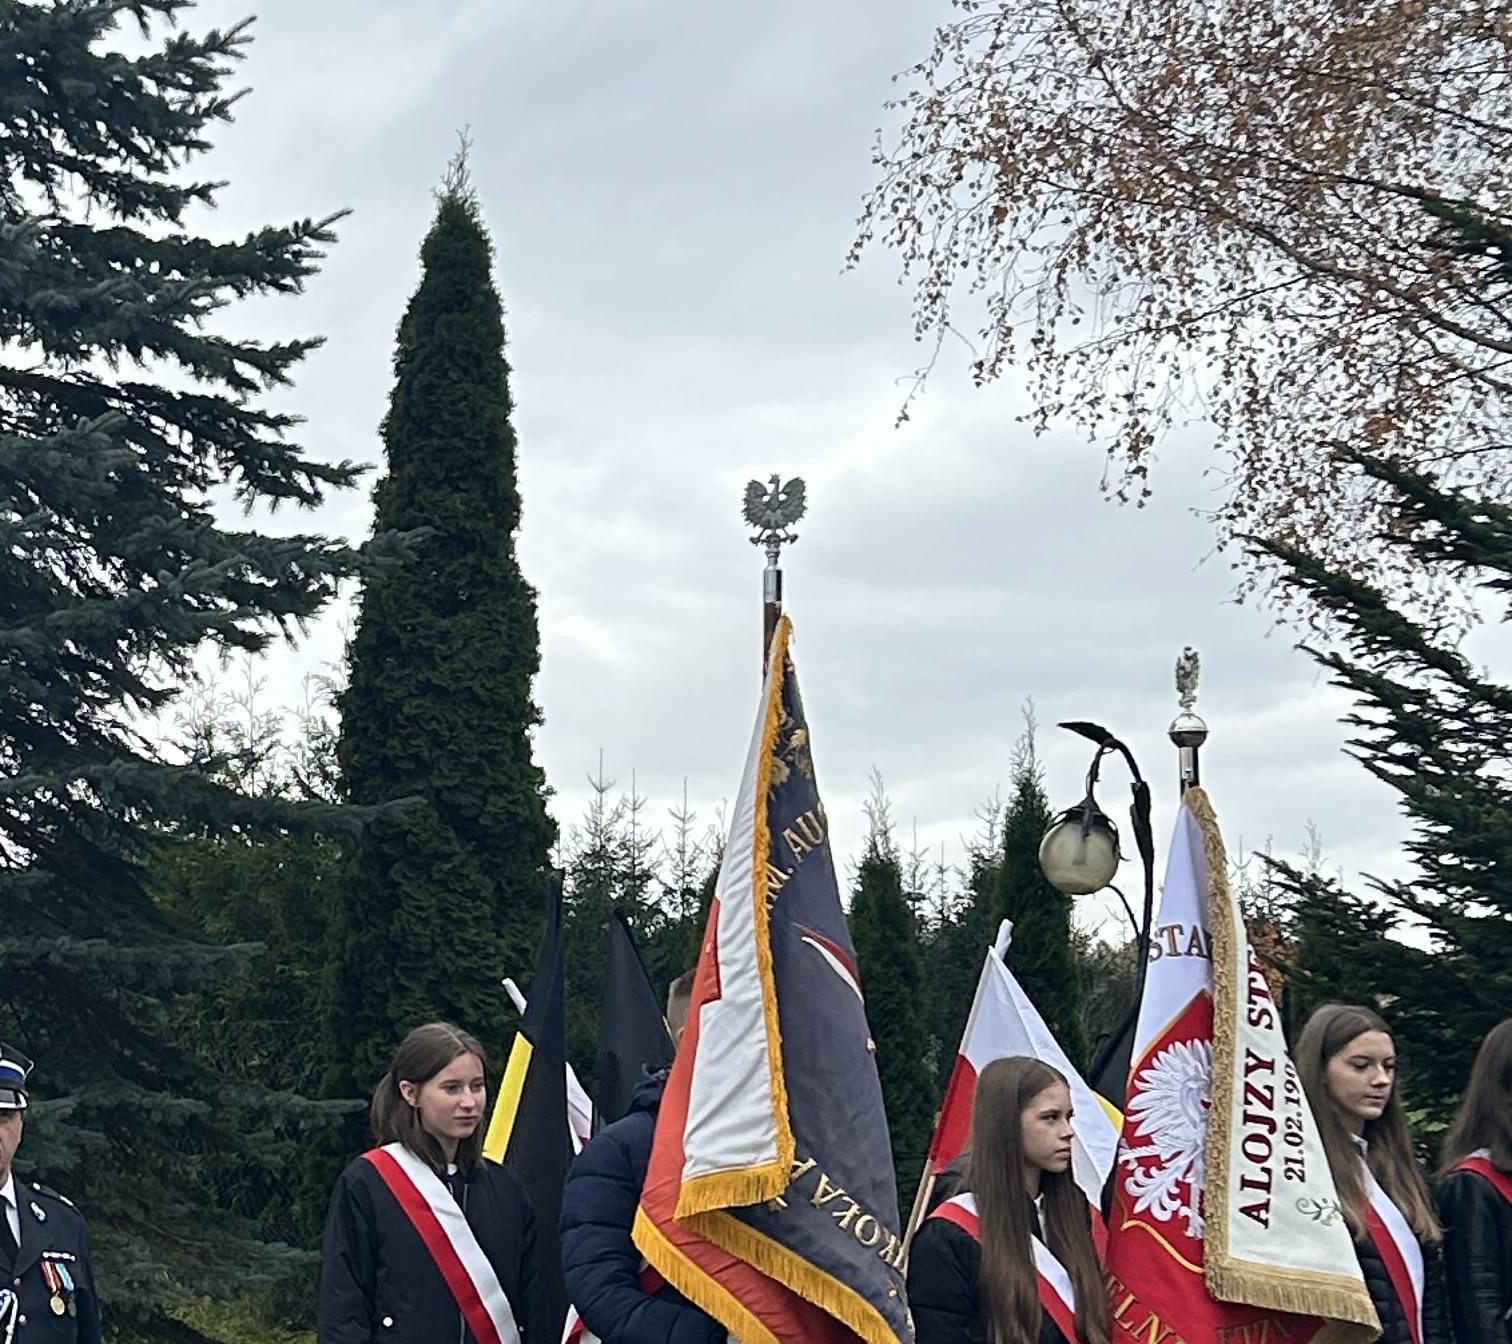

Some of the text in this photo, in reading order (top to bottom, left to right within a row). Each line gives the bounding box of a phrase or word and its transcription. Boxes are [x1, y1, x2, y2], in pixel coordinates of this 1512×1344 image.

[1149, 923, 1213, 963] STA
[1239, 1047, 1277, 1229] ALOJZY
[1284, 1050, 1306, 1184] 21.02.19
[810, 1173, 905, 1268] KOŁA
